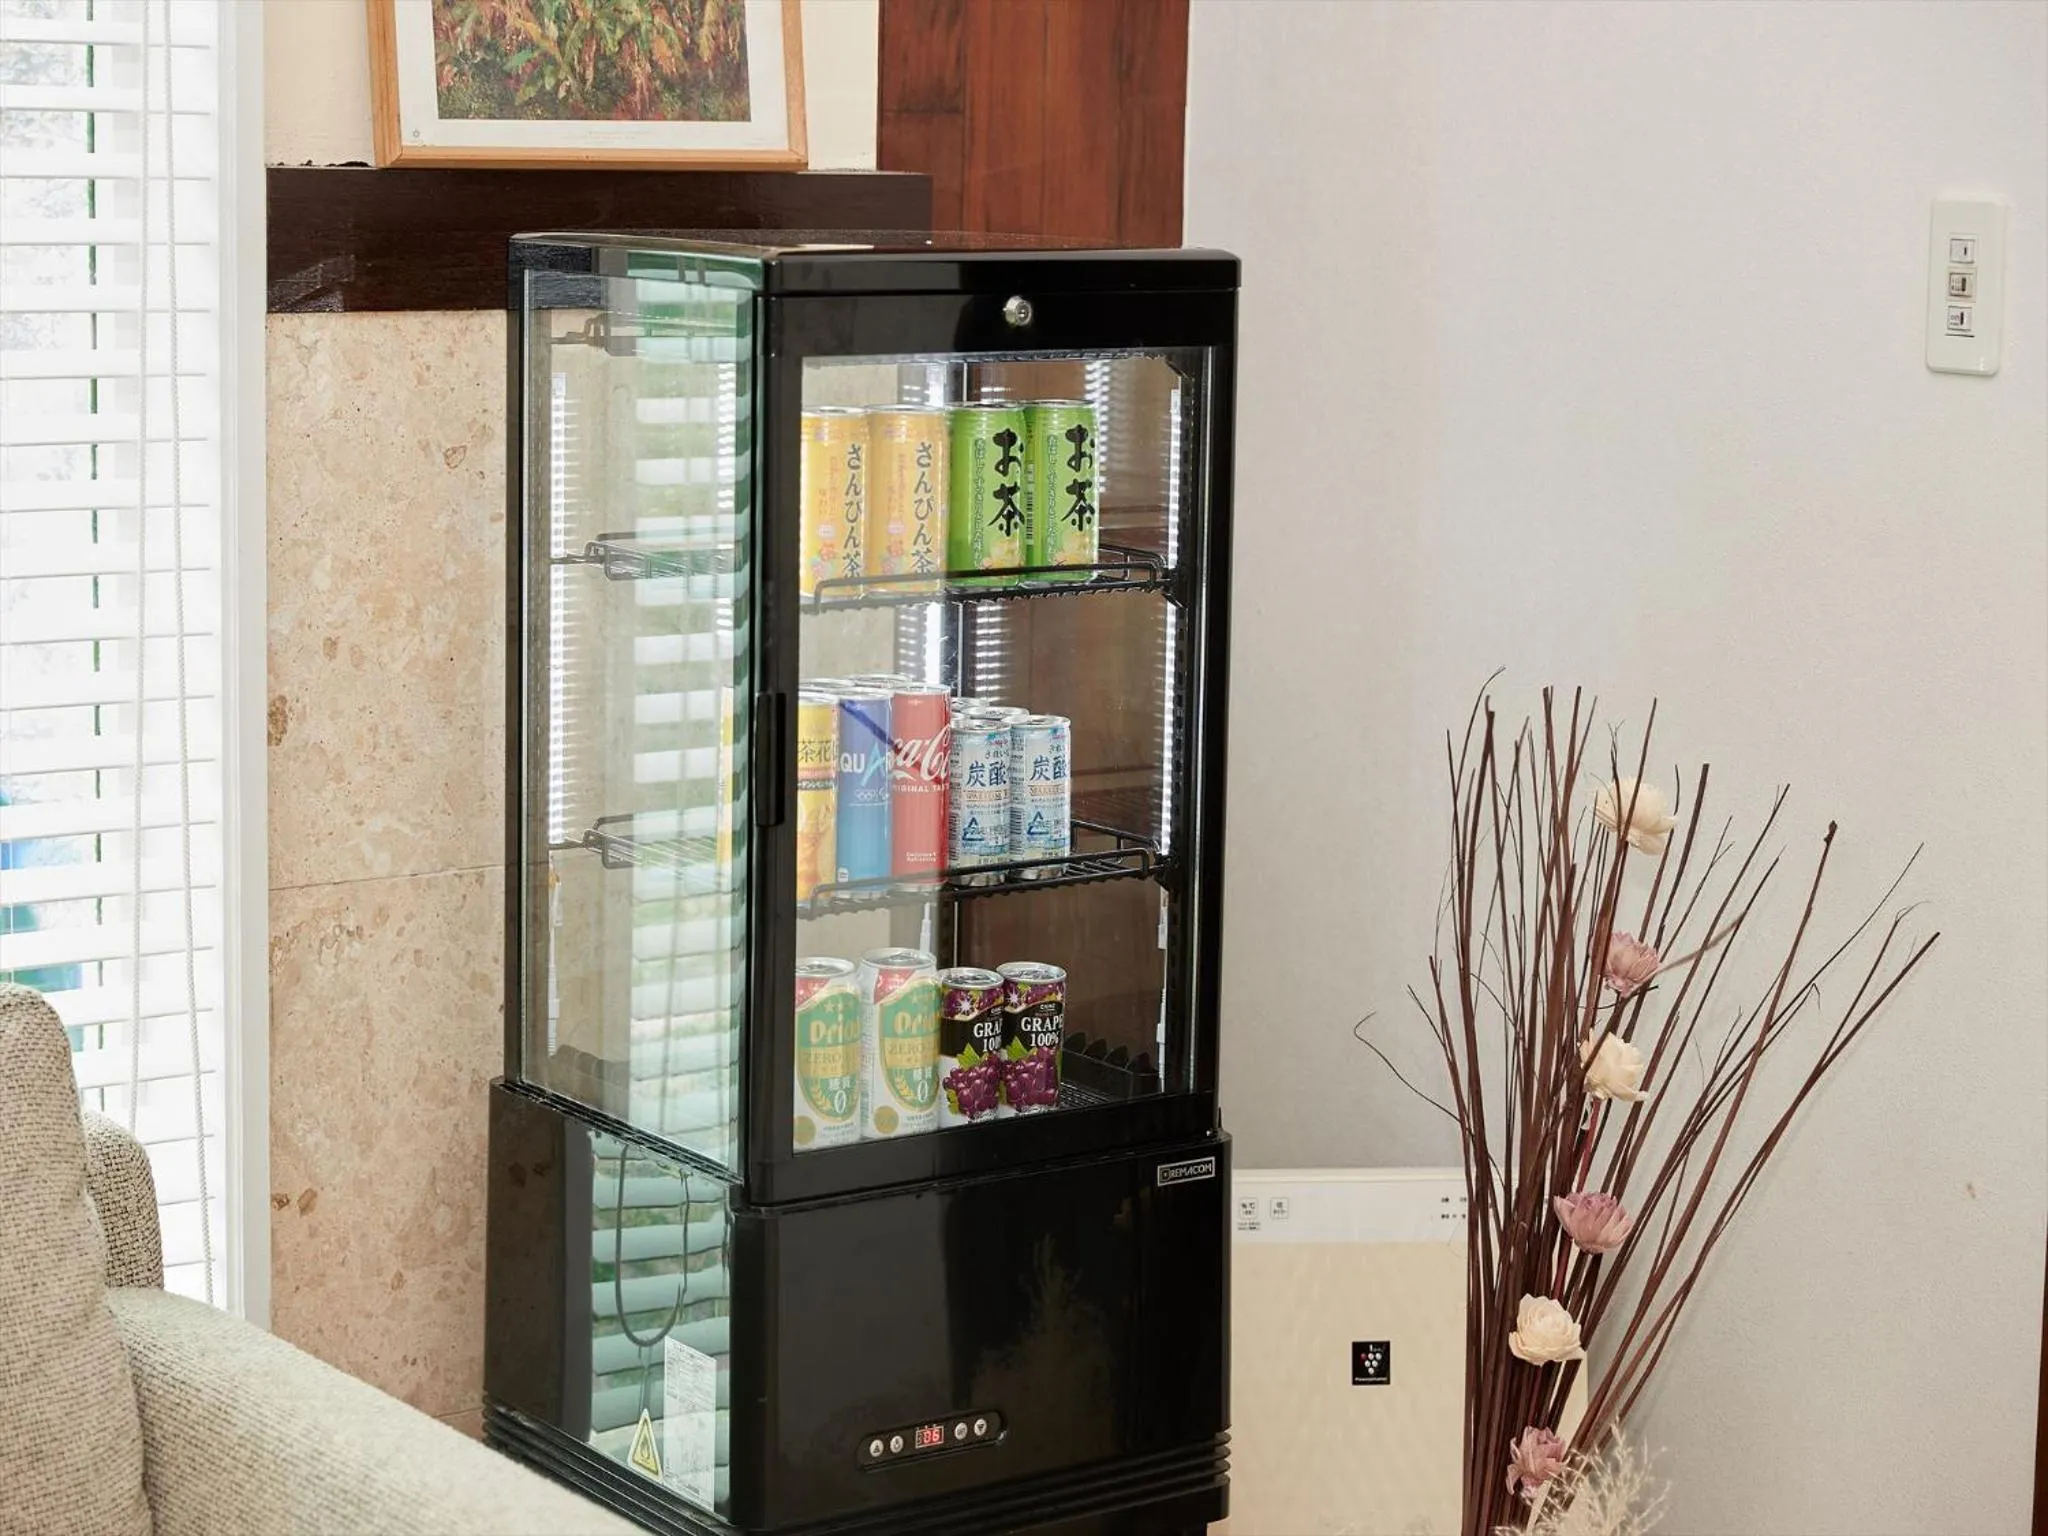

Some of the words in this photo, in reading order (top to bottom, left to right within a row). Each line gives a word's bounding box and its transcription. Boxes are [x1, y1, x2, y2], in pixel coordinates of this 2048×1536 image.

[987, 428, 1026, 538] お茶
[1061, 423, 1096, 532] お茶
[1030, 1031, 1060, 1047] 100%
